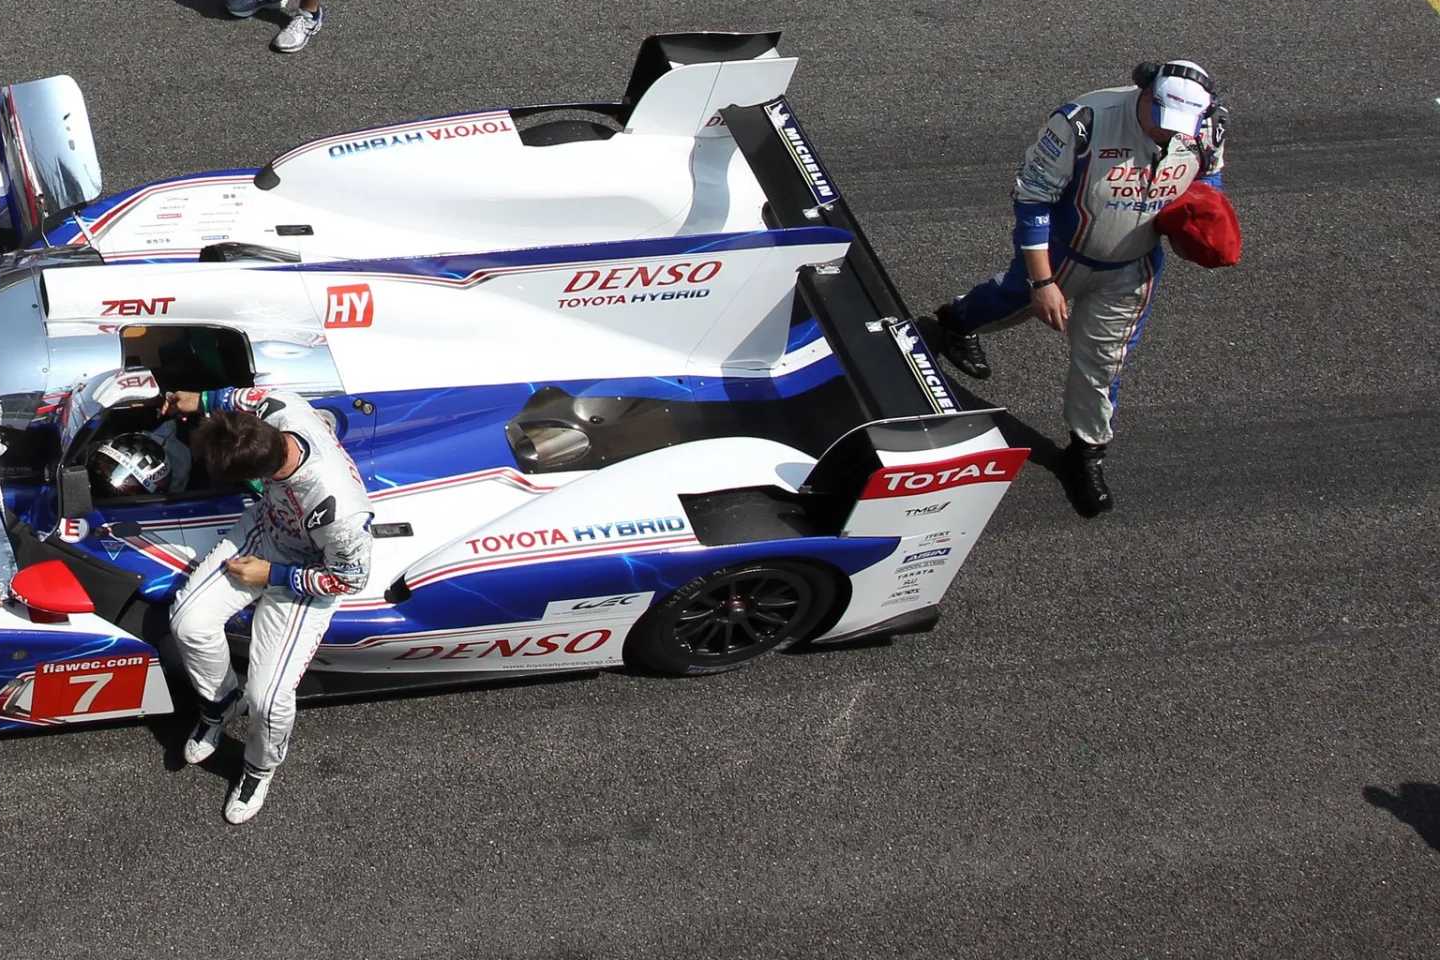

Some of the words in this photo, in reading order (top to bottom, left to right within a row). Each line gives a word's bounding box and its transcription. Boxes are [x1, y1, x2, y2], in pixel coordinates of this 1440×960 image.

[426, 120, 512, 141] TOYOTA
[329, 131, 425, 160] HYBRID
[1098, 148, 1133, 159] ZENT
[783, 125, 833, 199] MICHELIN
[1106, 163, 1188, 184] DENSO
[1111, 185, 1178, 198] TOYOTA
[562, 260, 724, 294] DENSO
[100, 297, 176, 317] ZENT
[327, 291, 370, 324] HY
[557, 295, 627, 309] TOYOTA
[630, 288, 711, 304] HYBRID
[913, 352, 958, 414] MICHE
[883, 460, 1007, 492] TOTAL
[905, 501, 948, 517] TMG
[65, 519, 81, 537] E
[466, 528, 569, 555] TOYOTA
[572, 515, 686, 543] HYBRID
[906, 548, 948, 562] AISIN
[571, 594, 642, 611] WEC
[392, 628, 612, 662] DENSO
[42, 655, 144, 674] fiawec.com
[68, 672, 114, 714] 7
